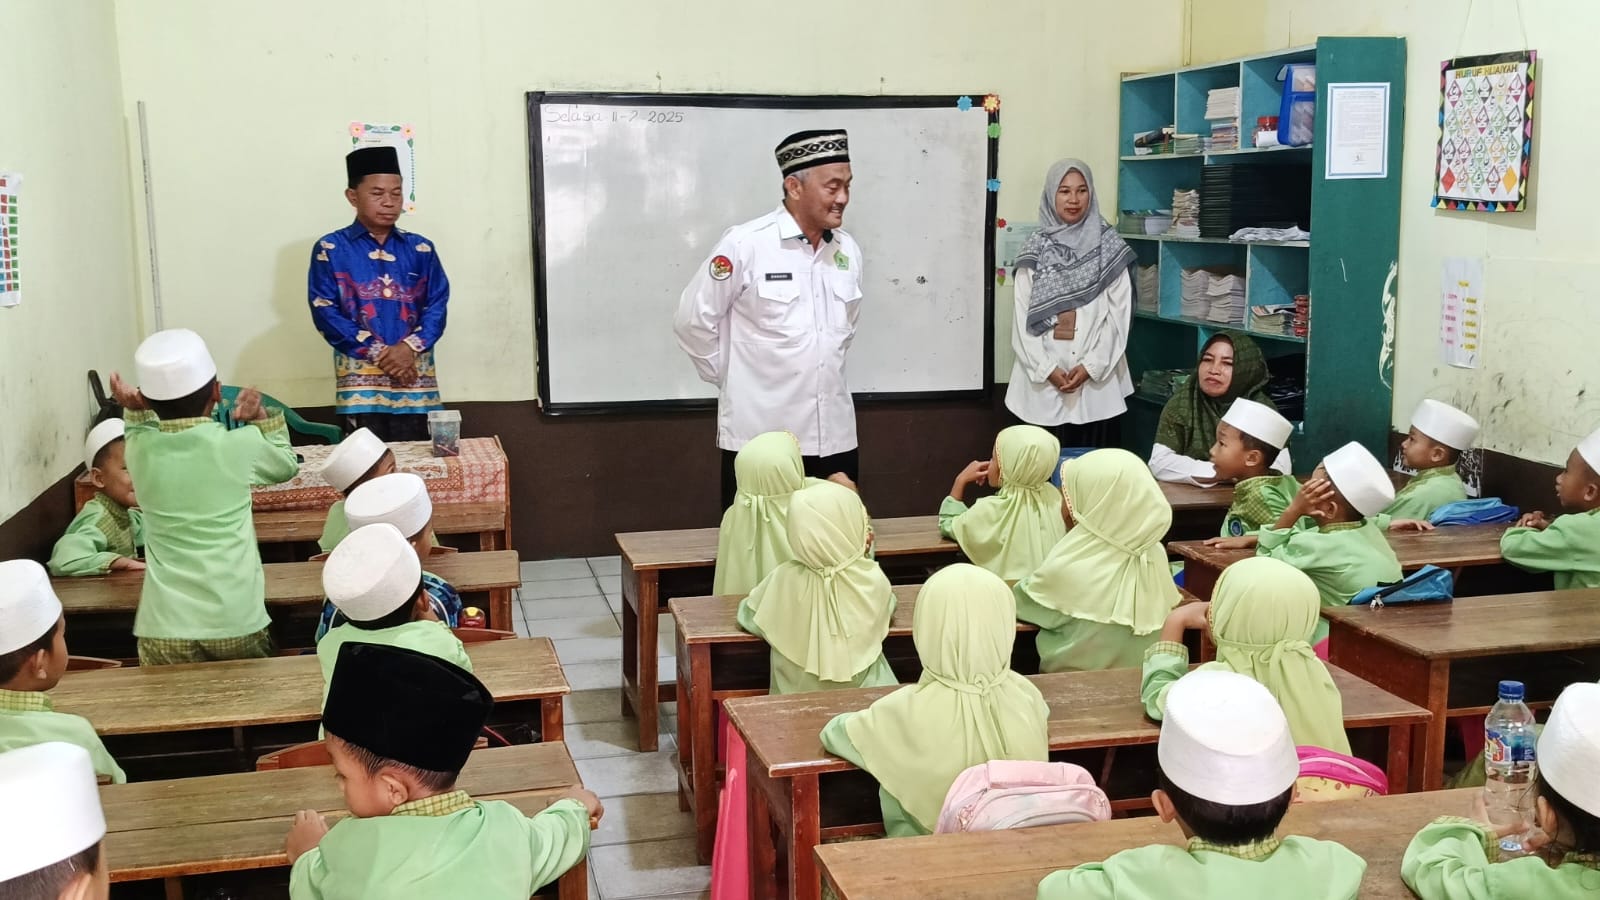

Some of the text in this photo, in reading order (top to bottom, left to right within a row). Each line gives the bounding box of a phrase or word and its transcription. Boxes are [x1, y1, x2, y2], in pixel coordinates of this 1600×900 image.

[1455, 67, 1482, 78] HURUF
[544, 104, 602, 123] Selasa
[647, 110, 685, 124] 2025
